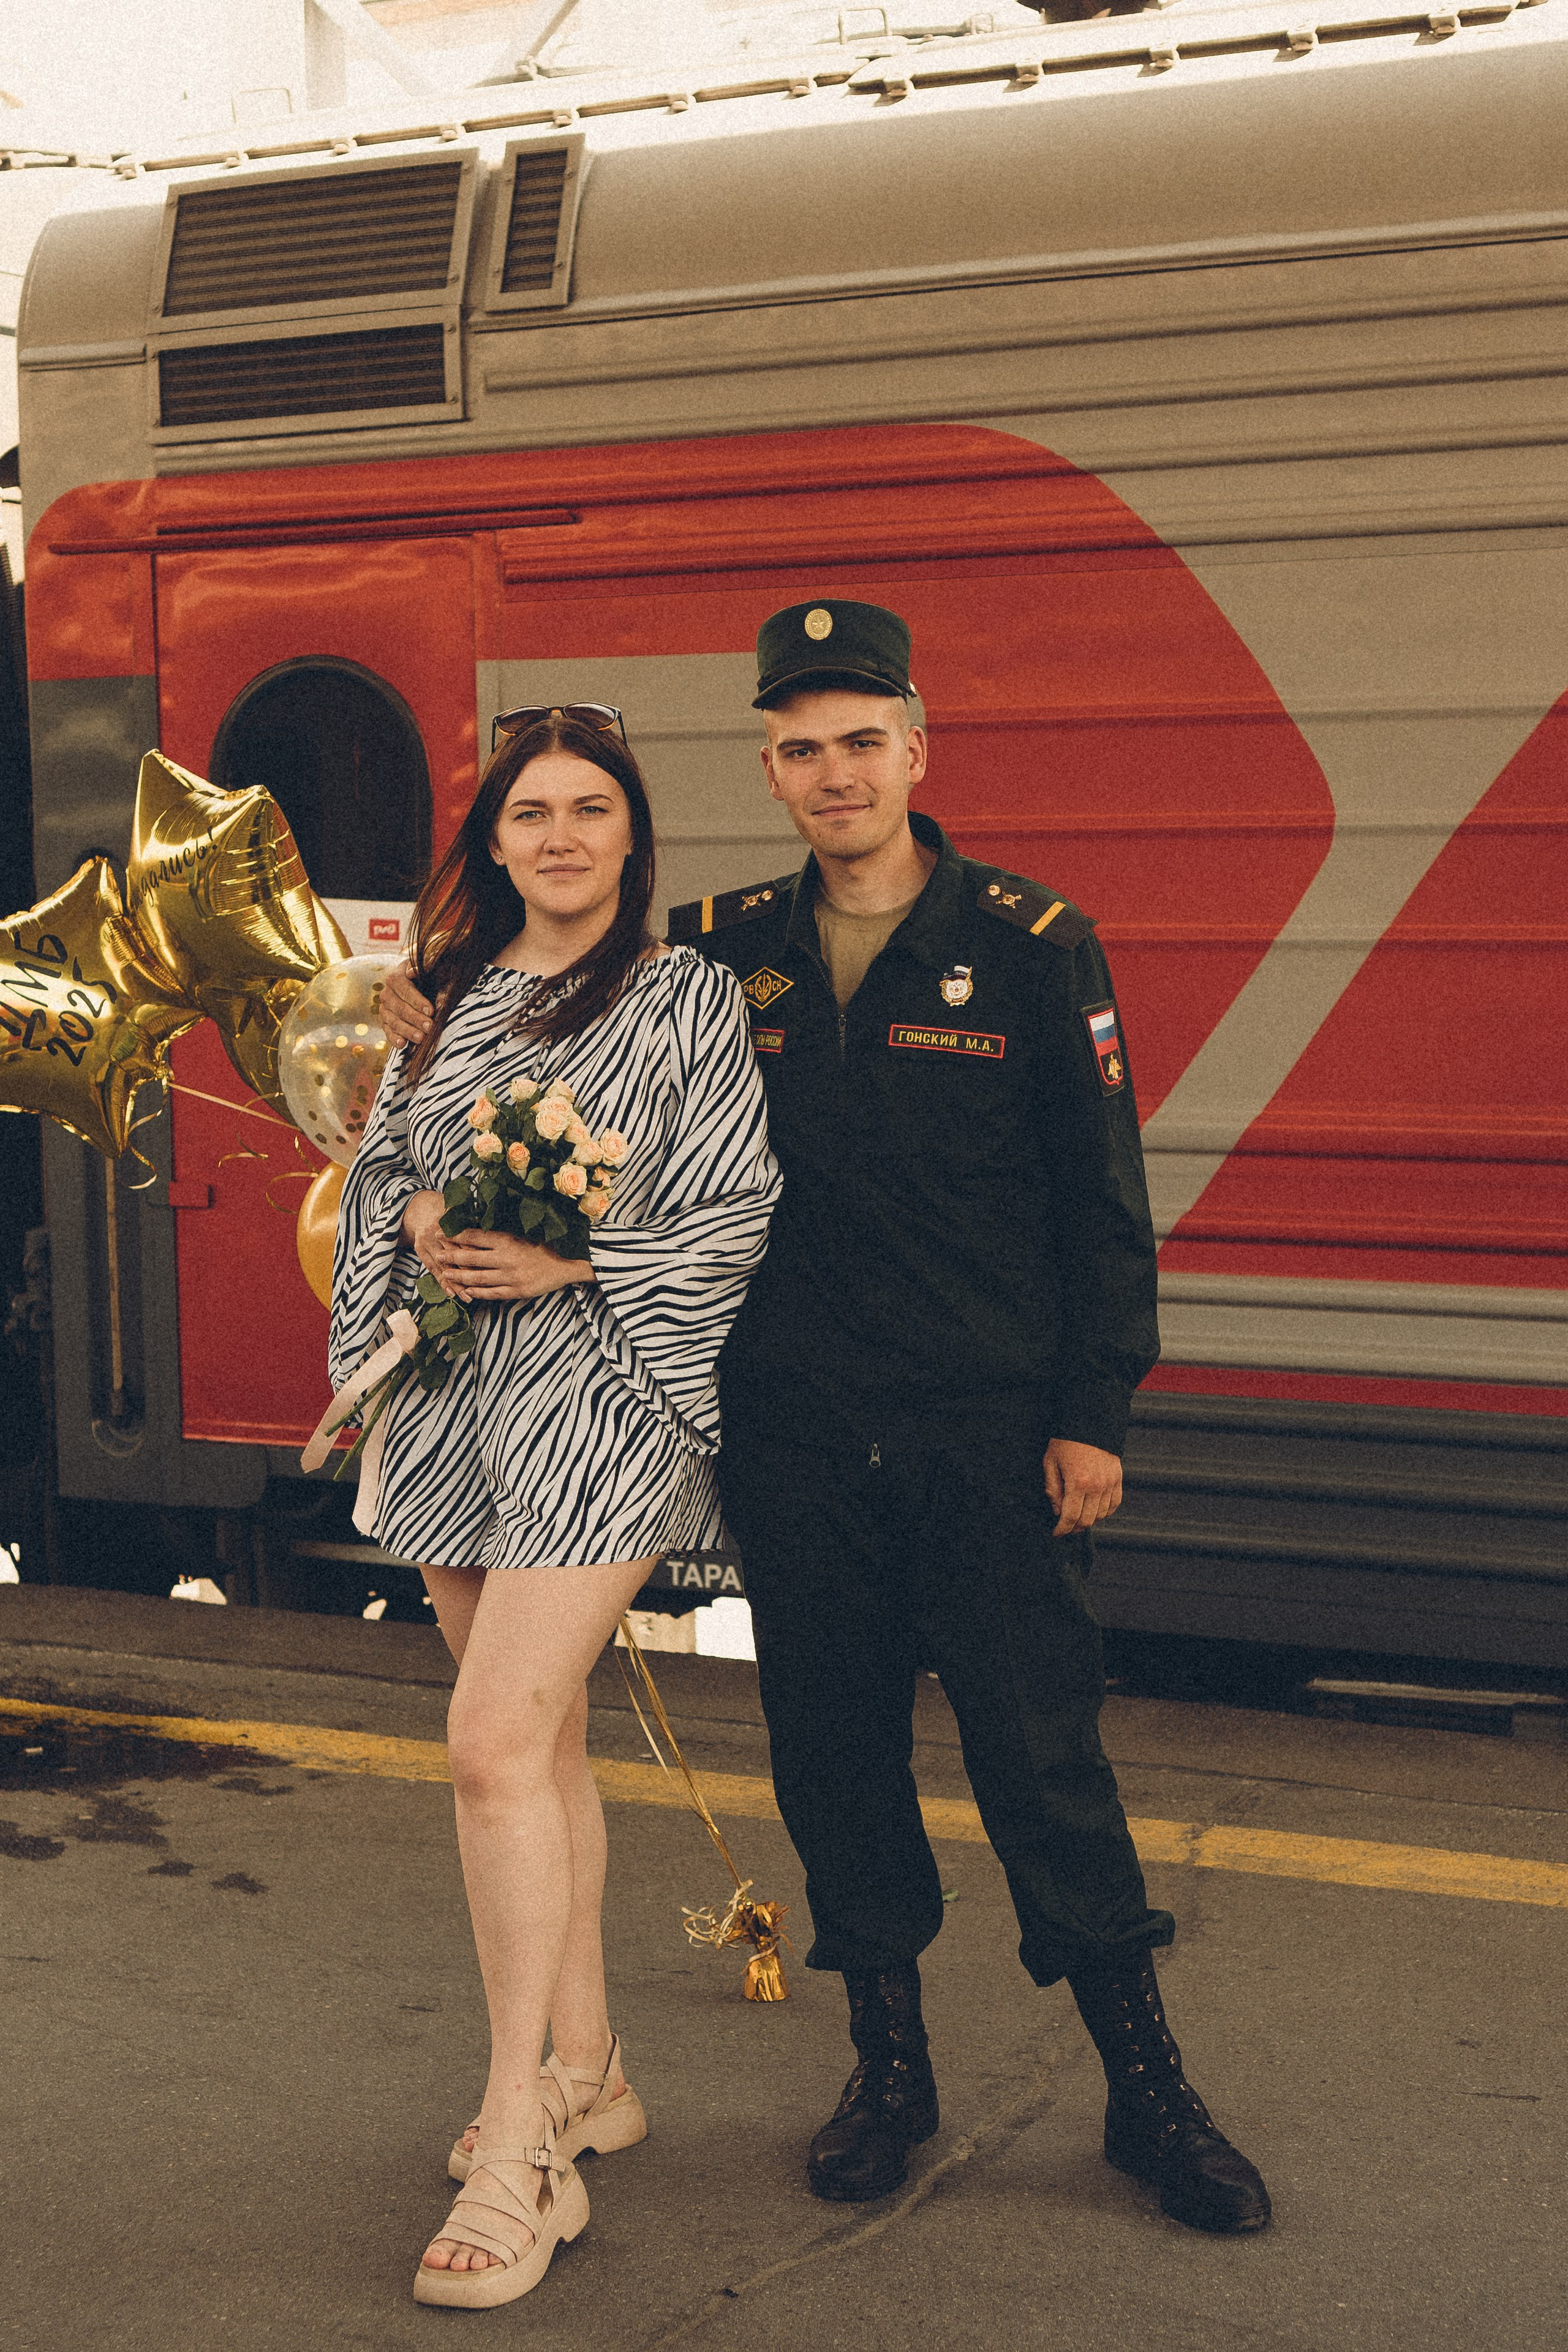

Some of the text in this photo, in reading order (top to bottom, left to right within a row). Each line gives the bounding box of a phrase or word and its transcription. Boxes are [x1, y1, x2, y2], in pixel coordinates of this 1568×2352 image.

[46, 956, 118, 1067] 2025
[899, 1031, 994, 1052] ГОНСКИЙ М.А.
[666, 1561, 742, 1591] ТАРА
